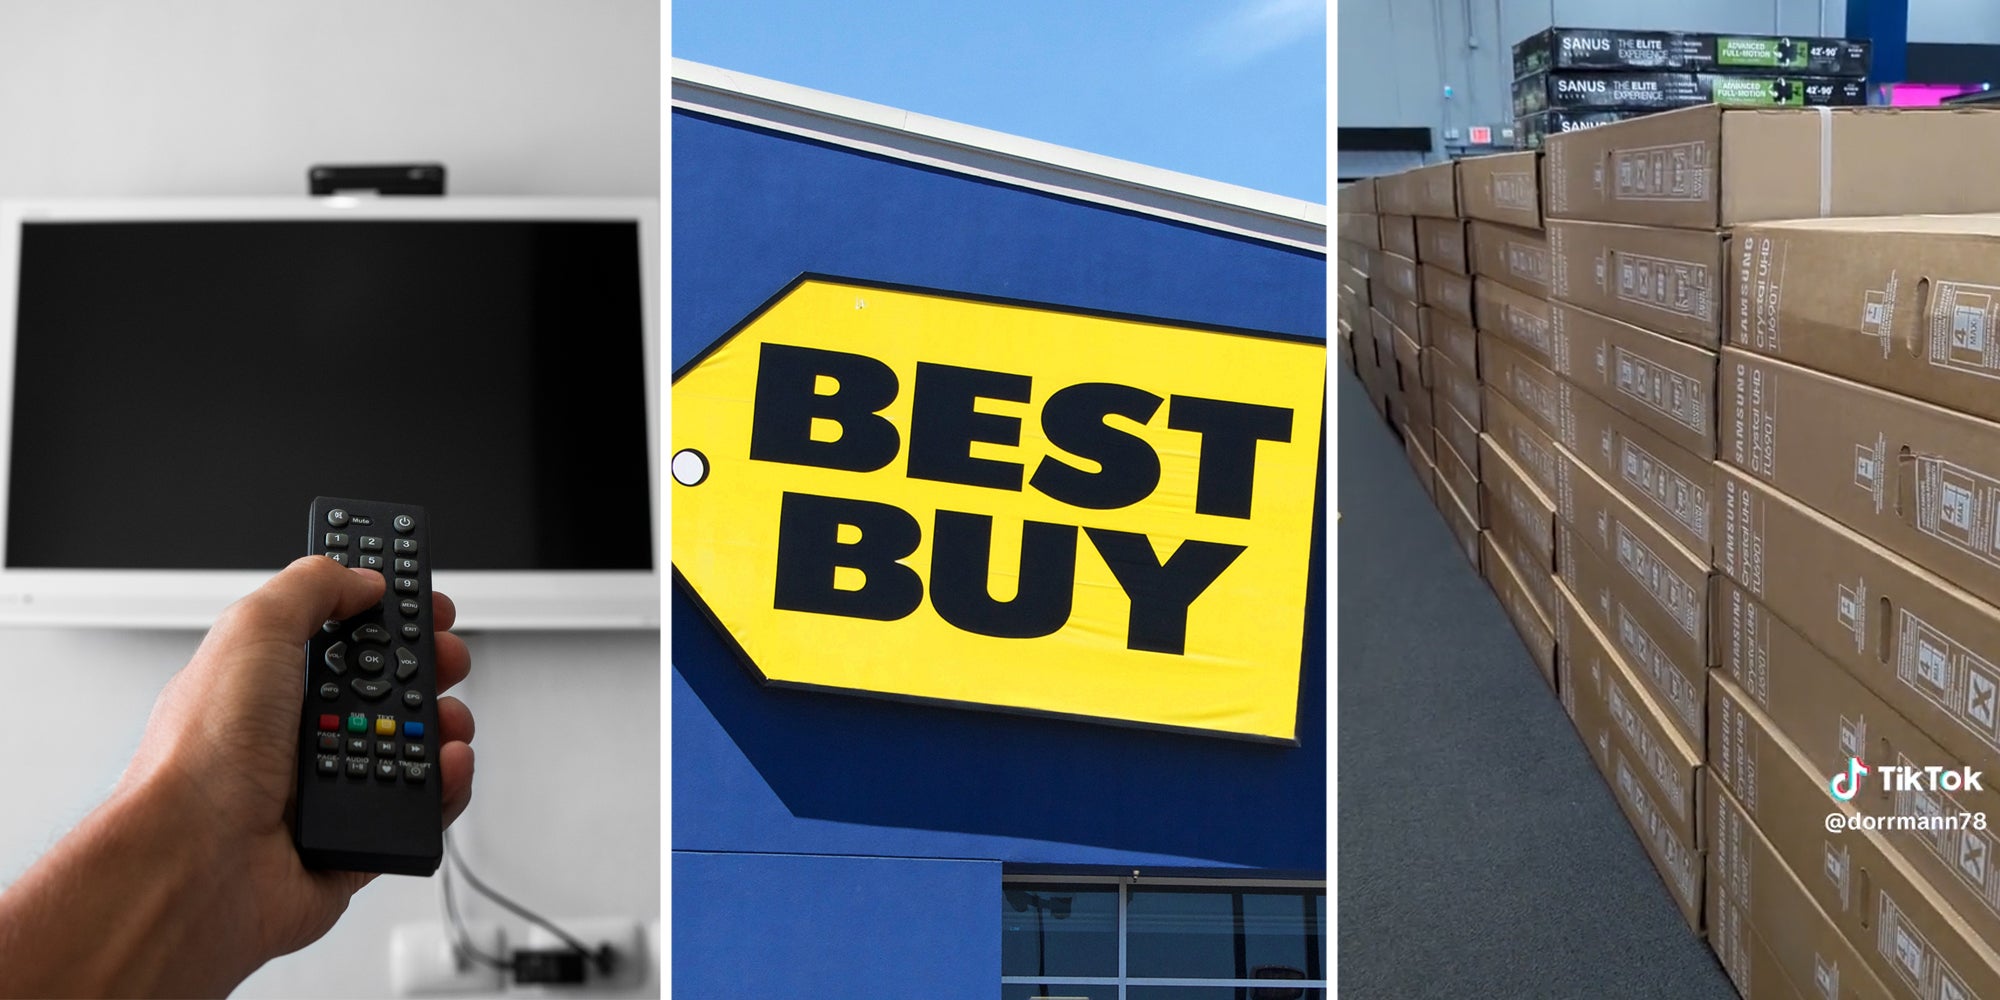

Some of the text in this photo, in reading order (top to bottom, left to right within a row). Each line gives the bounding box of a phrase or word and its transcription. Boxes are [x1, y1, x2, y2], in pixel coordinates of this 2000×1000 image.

[1563, 38, 1610, 50] SANUS
[1618, 39, 1635, 48] THE
[1636, 40, 1662, 50] ELITE
[1727, 42, 1765, 50] ADVANCED
[1618, 50, 1668, 59] EXPERIENCE
[1722, 50, 1770, 58] FULL-MOTION
[1558, 80, 1606, 92] SANUS
[1613, 81, 1630, 90] THE
[1632, 82, 1657, 91] ELITE
[1718, 90, 1766, 98] FULL-MOTION
[1722, 81, 1760, 90] ADVANCED
[1614, 91, 1663, 100] EXPERIENCE
[1740, 237, 1754, 344] SAMSUNG
[1756, 238, 1770, 348] Crystal UHD
[1768, 281, 1778, 351] TU690T
[1954, 328, 1967, 344] 4
[1970, 322, 1978, 345] MAX
[1735, 364, 1745, 464] SAMSUNG
[1751, 369, 1761, 472] Crystal UHD
[750, 342, 1294, 520] BEST
[1764, 413, 1773, 477] TU690T
[1943, 504, 1954, 520] 4
[1726, 480, 1735, 576] SAMSUNG
[1742, 490, 1751, 586] Crystal UHD
[773, 491, 1248, 656] BUY
[1753, 535, 1761, 594] TU690T
[1747, 602, 1756, 694] Crystal UHD
[1920, 660, 1930, 675] 4
[1722, 696, 1730, 783] SAMSUNG
[346, 756, 369, 764] AUDIO
